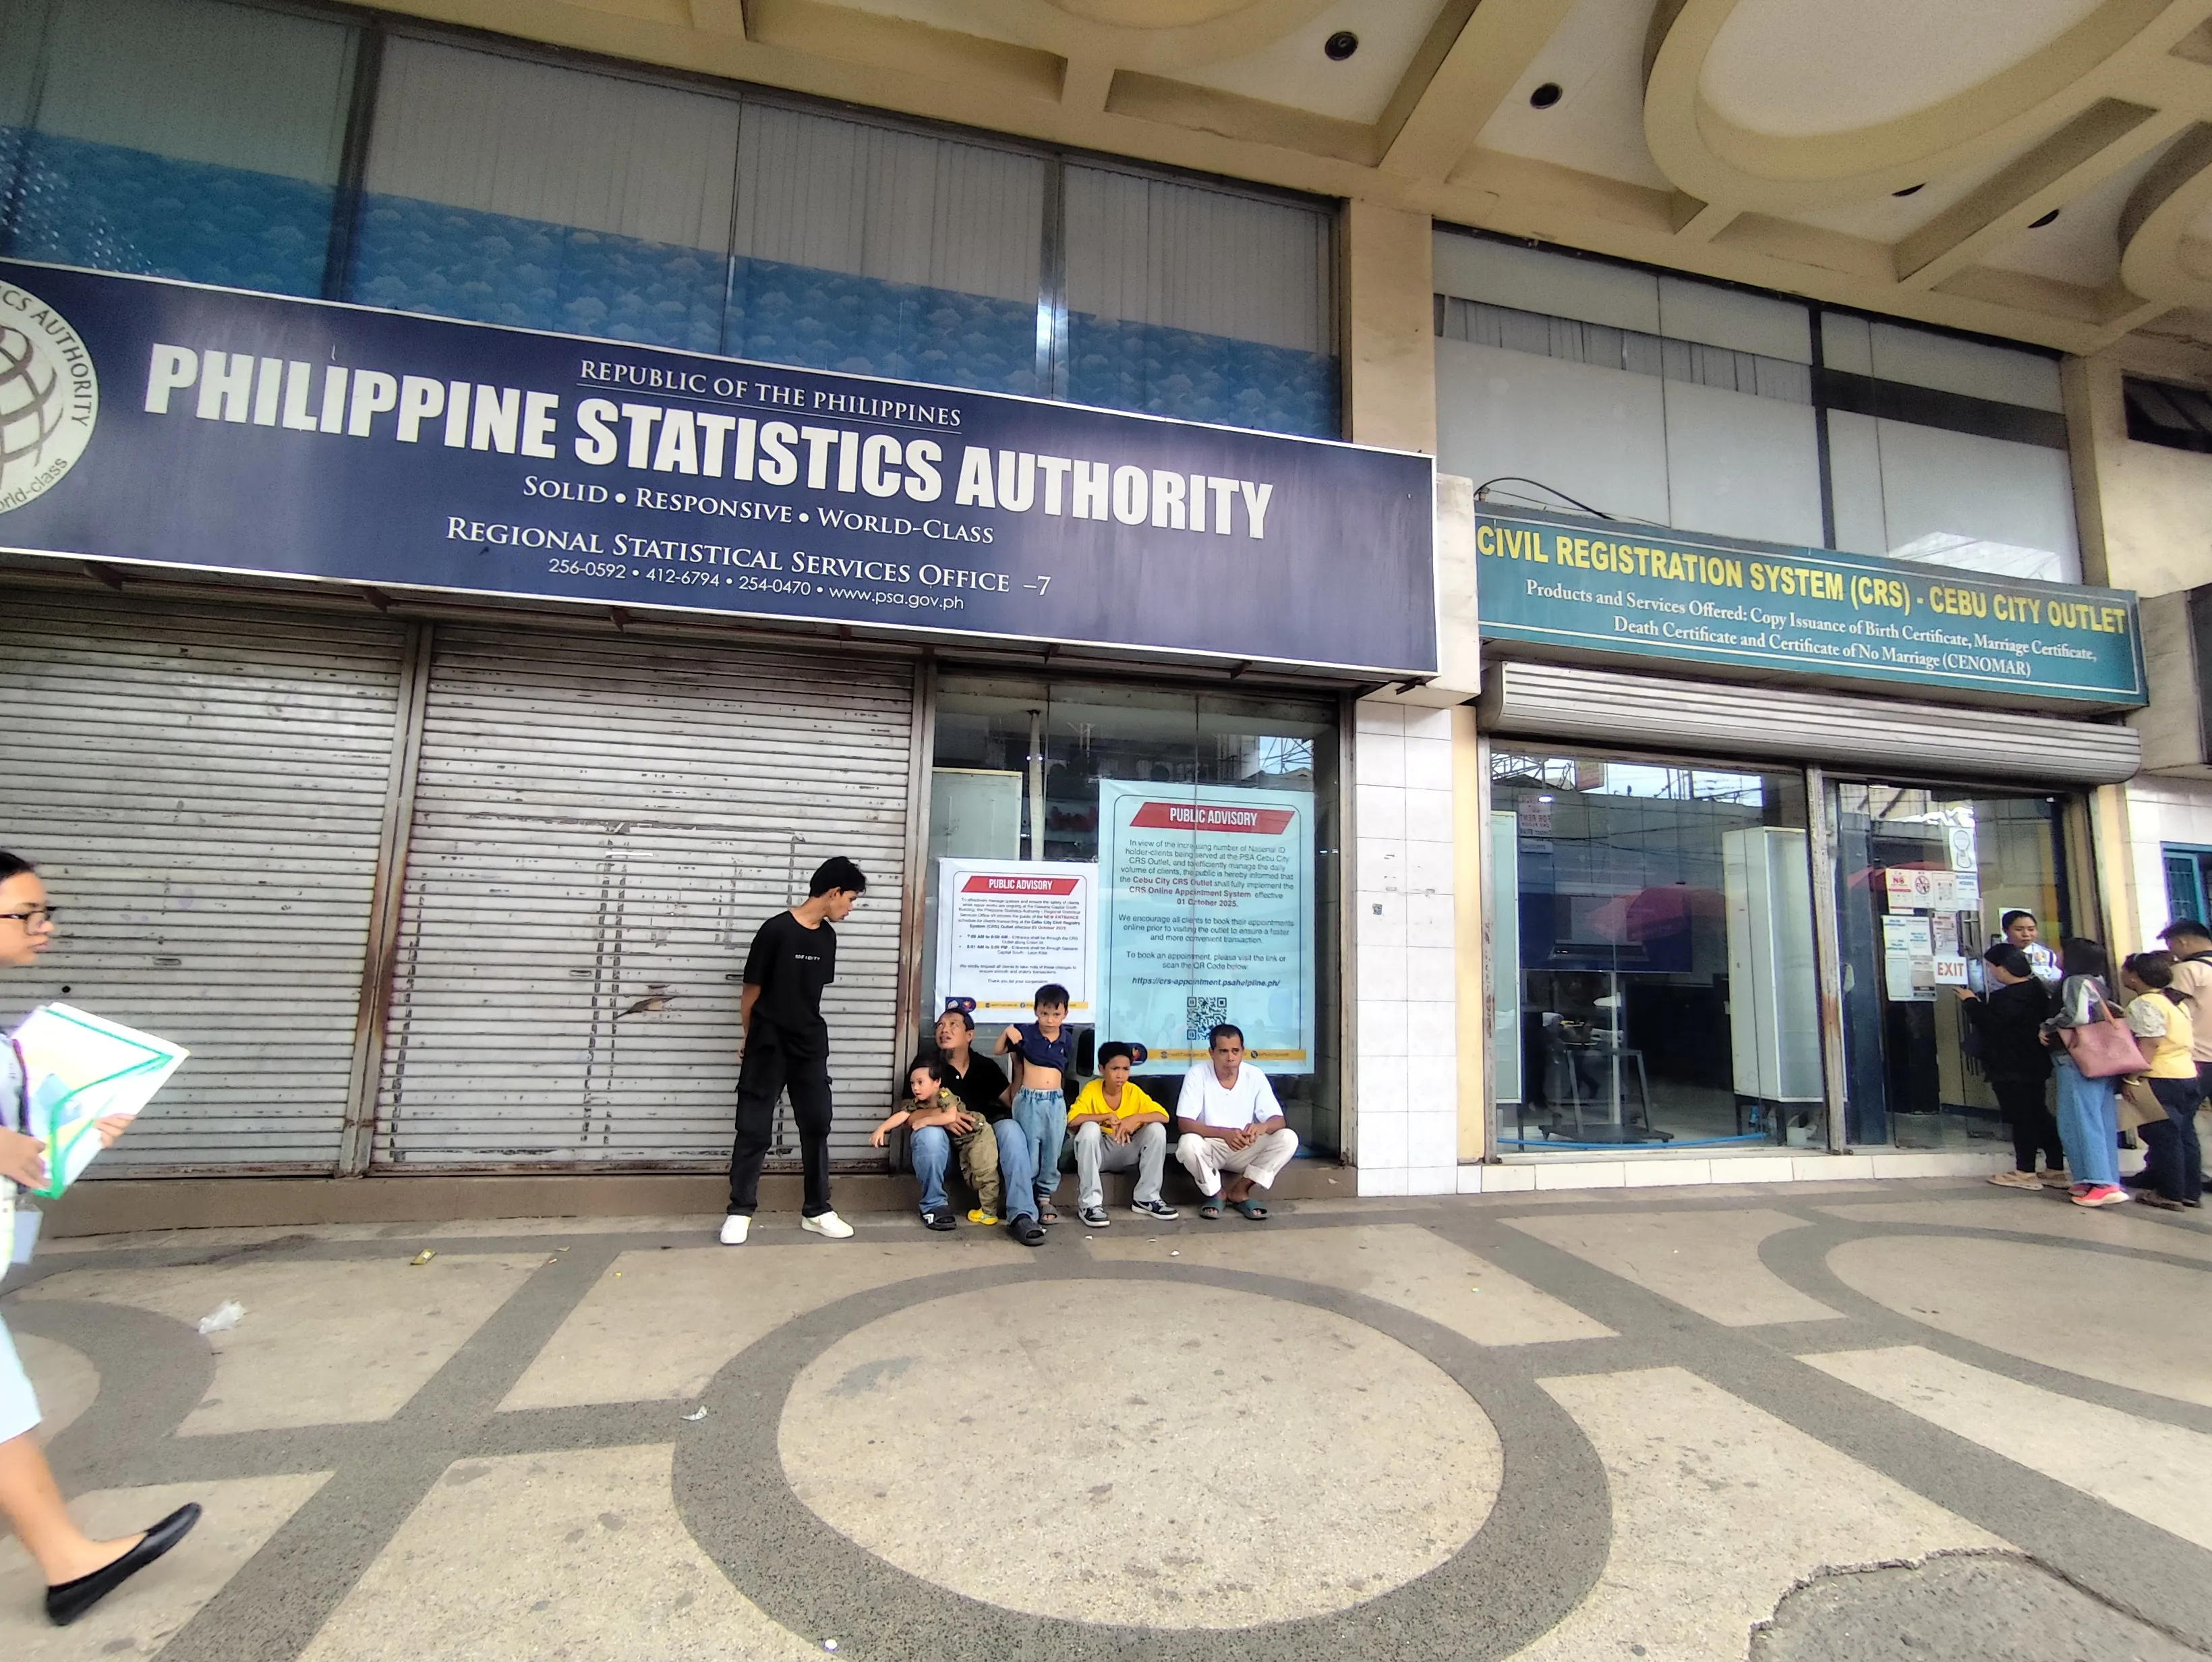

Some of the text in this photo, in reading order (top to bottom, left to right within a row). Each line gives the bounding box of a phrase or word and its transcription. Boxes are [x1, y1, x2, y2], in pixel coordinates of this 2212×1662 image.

[30, 309, 93, 428] AUTHORITY
[580, 360, 961, 426] REPUBLIC OF THE PHILIPPINES
[145, 344, 1273, 539] PHILIPPINE STATISTICS AUTHORITY
[549, 558, 963, 610] 256-0592 412-6794 254-0470 www.psa.gov.ph
[1478, 526, 1548, 563] CIVIL
[1556, 536, 1743, 588] REGISTRATION
[1750, 563, 1843, 600] SYSTEM
[1851, 575, 1910, 615] (CRS)
[1930, 585, 1987, 617] CEBU
[1993, 594, 2040, 623] CITY
[2047, 601, 2124, 633] OUTLET
[1527, 579, 2097, 661] Products and Services Offered: Copy Issuance of Birth Certificate, Marriage Certificate,
[1614, 616, 2031, 677] Death Certificate and Certificate of No Marriage (CENOMAR)
[1170, 808, 1257, 826] PUBLIC ADVISORY
[1195, 861, 1226, 869] efficiently
[1271, 864, 1285, 872] daily
[1277, 855, 1289, 863] City
[1195, 869, 1215, 878] public
[1225, 871, 1247, 880] hereby
[989, 878, 1053, 890] PUBLIC ADVISORY
[1155, 878, 1169, 886] City
[1231, 880, 1244, 888] fully
[1248, 882, 1281, 890] implement
[1175, 889, 1221, 898] Appointment
[1224, 890, 1251, 898] System
[1146, 925, 1162, 933] prior
[1173, 926, 1196, 934] visiting
[1248, 919, 1294, 927] appointments
[1937, 961, 1964, 977] EXIT
